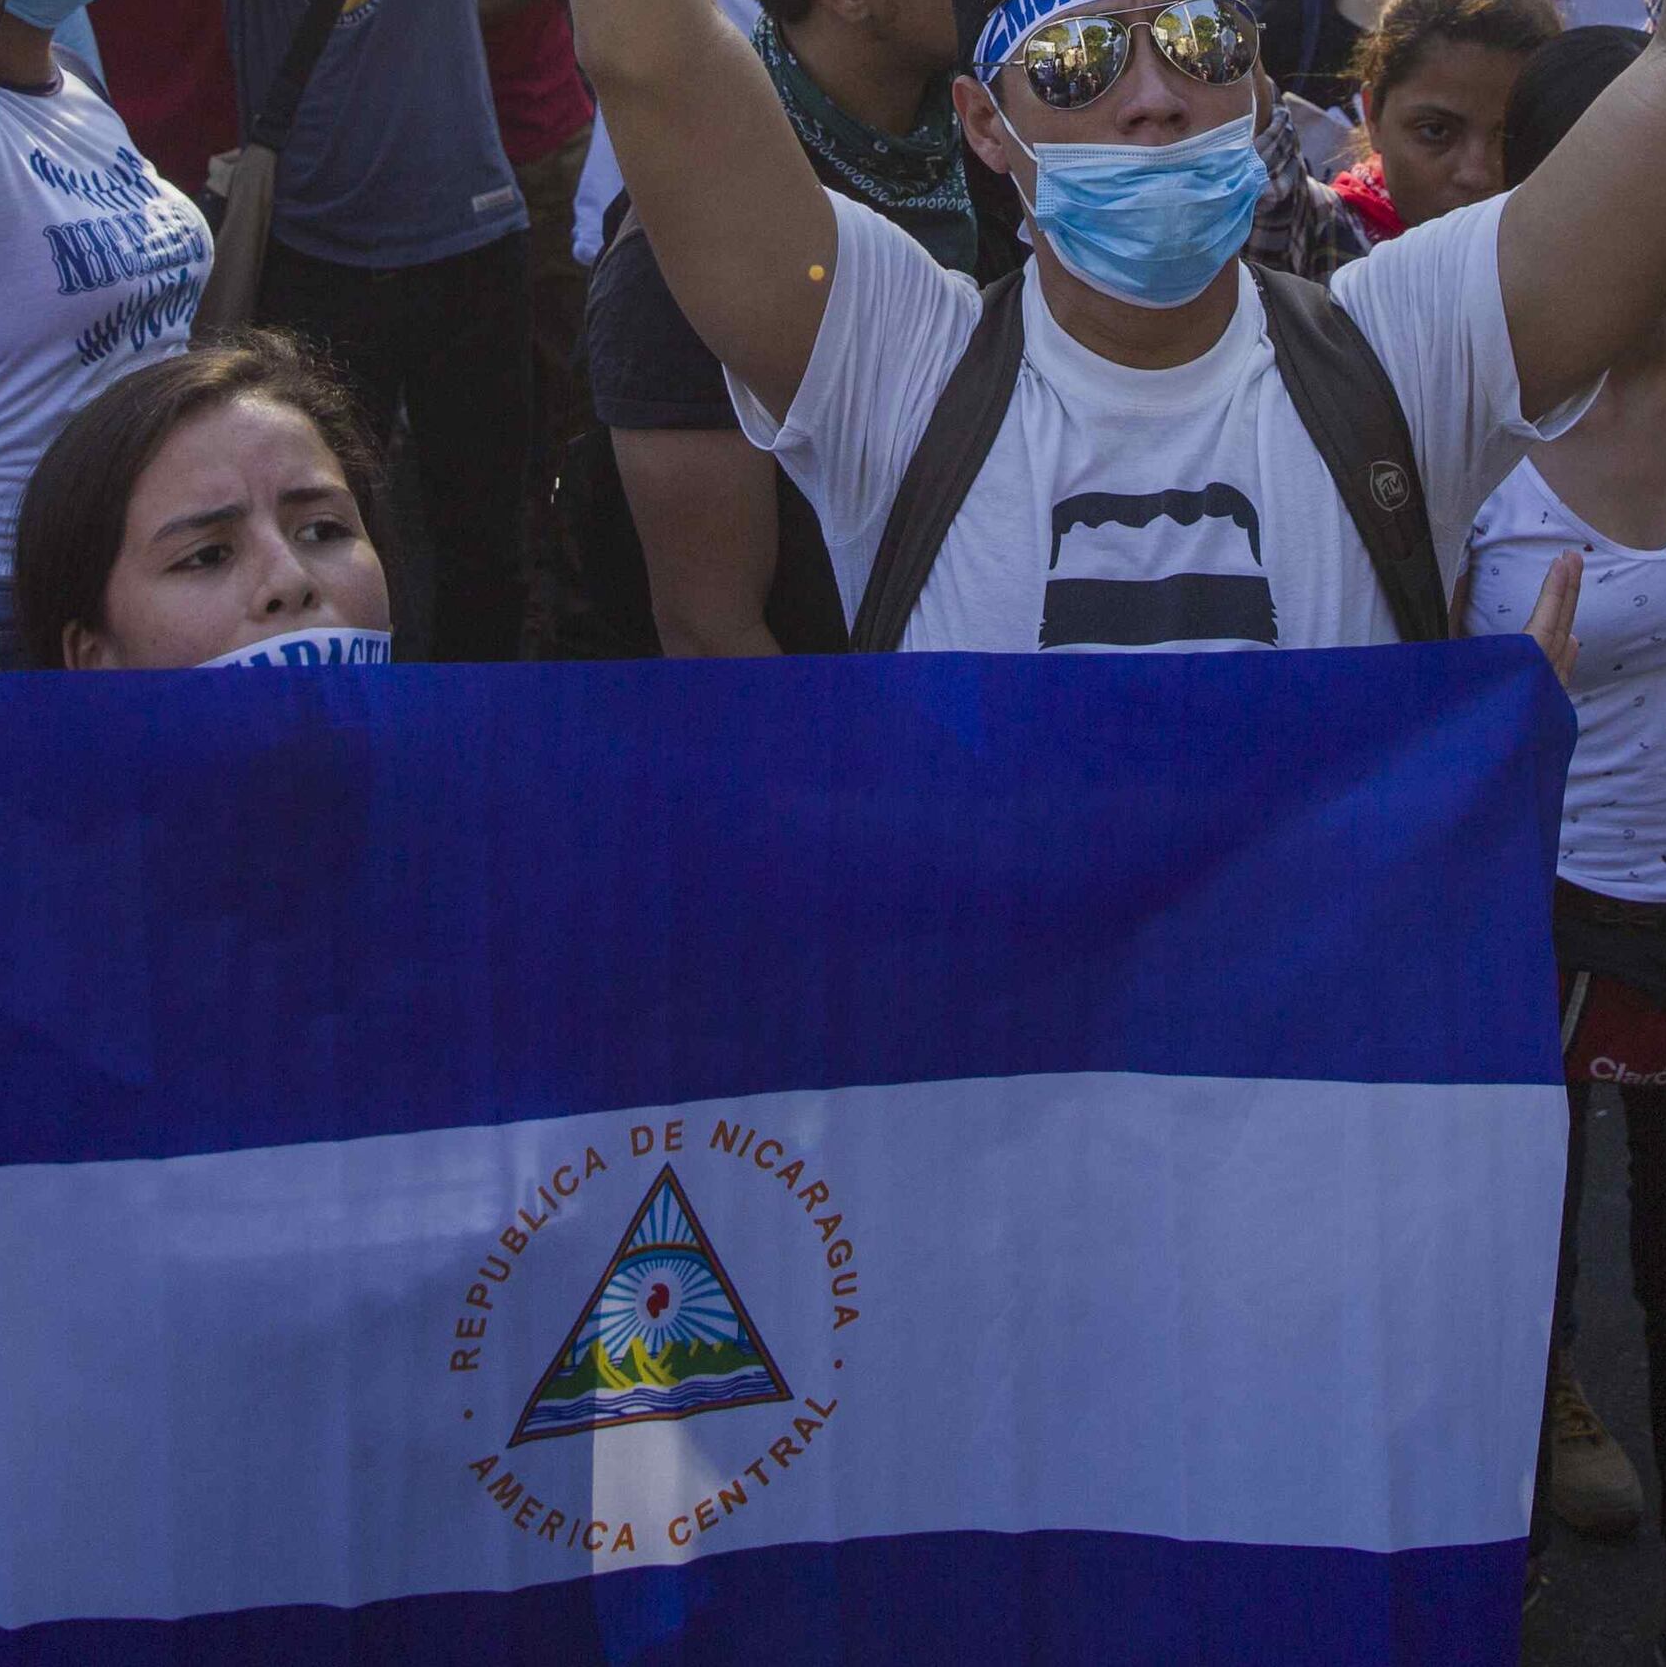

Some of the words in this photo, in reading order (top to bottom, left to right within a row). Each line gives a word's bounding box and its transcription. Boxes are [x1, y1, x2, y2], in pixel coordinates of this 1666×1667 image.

[449, 1145, 608, 1372] REPUBLICA
[630, 1120, 683, 1157] DE
[709, 1119, 860, 1330] NICARAGUA
[468, 1452, 635, 1553] AMERICA
[667, 1394, 838, 1547] CENTRAL
